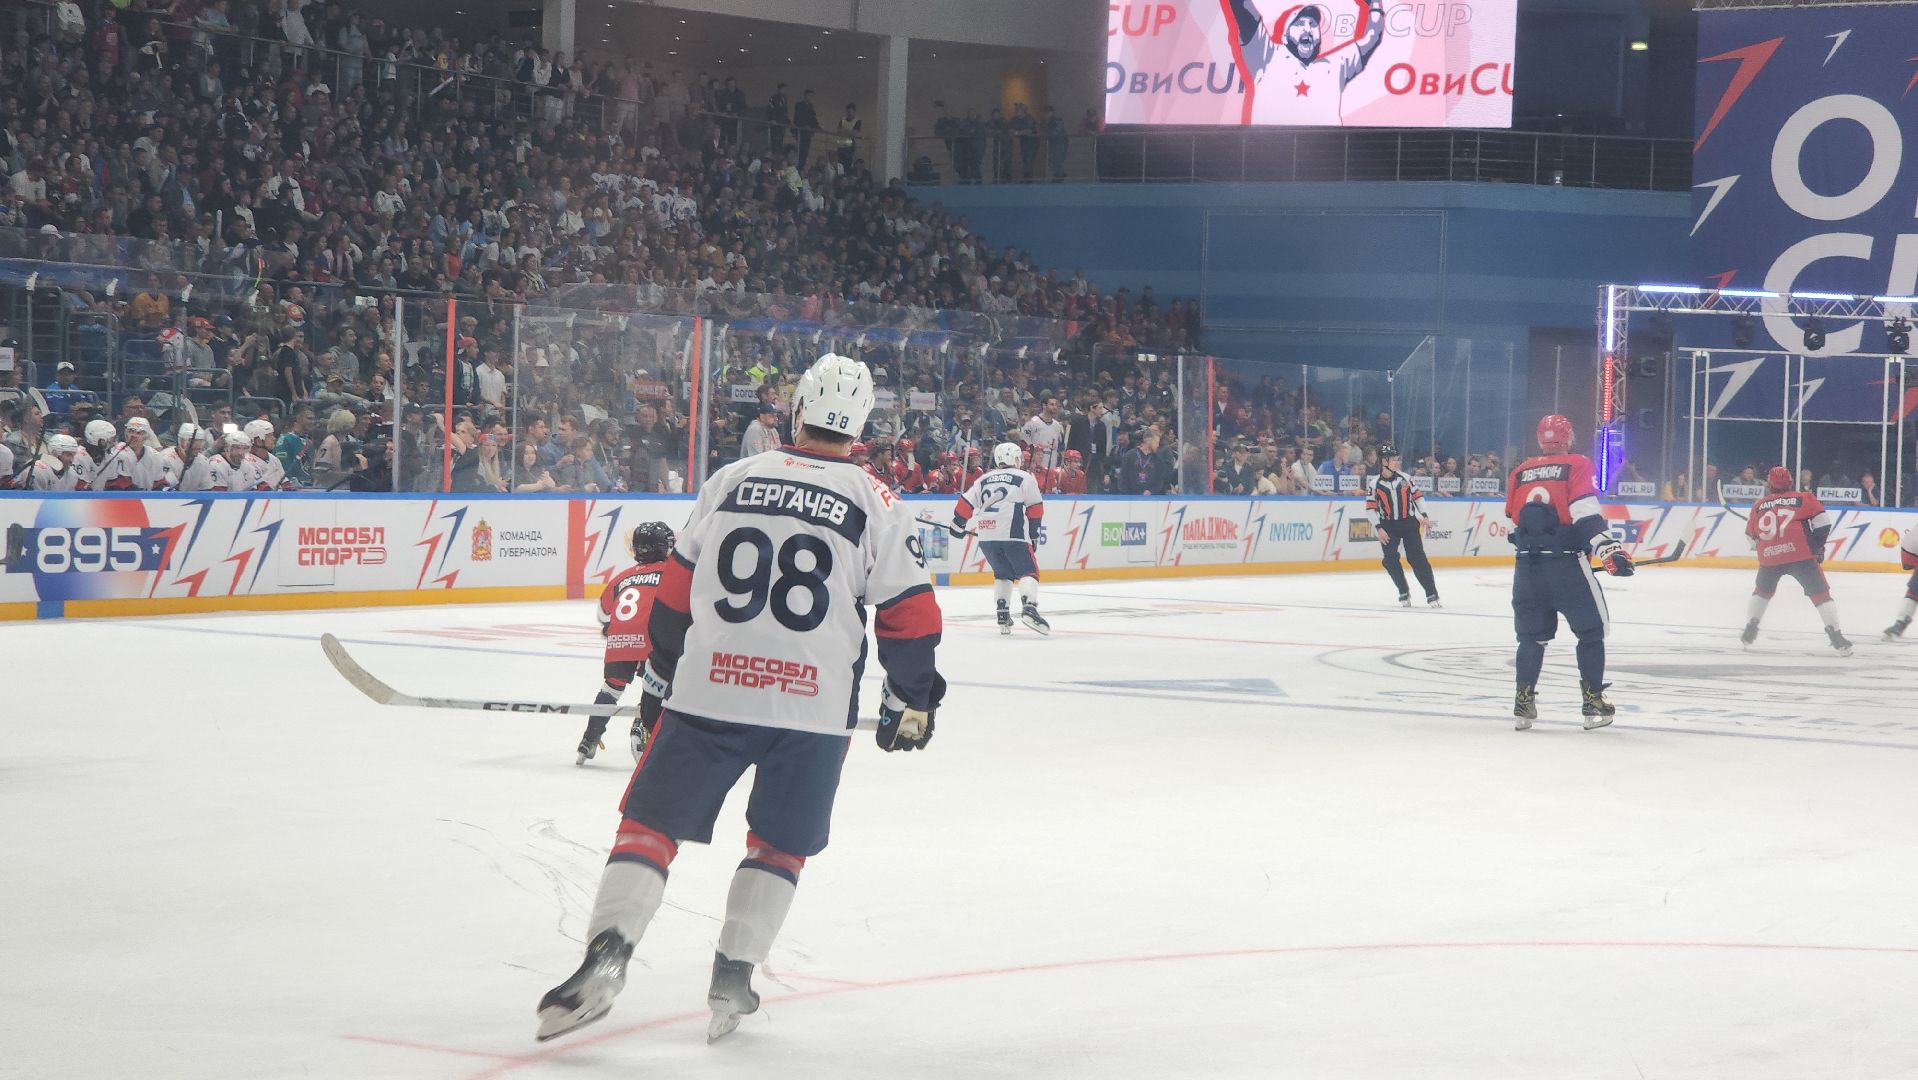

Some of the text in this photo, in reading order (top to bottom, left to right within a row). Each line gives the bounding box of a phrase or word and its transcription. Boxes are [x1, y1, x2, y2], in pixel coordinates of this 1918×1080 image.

[1104, 61, 1244, 94] ОвиCU
[826, 411, 849, 430] 98
[1725, 486, 1762, 497] KHL.RU
[1820, 488, 1859, 499] KHL.RU
[735, 480, 849, 526] СЕРГАЧЕВ
[499, 530, 543, 541] КОМАНДА
[1183, 517, 1238, 541] ПАПА ДЖОНС
[1269, 522, 1313, 542] INVITRO
[1758, 508, 1796, 541] 97
[36, 527, 143, 573] 895
[298, 547, 366, 566] СПОРТ
[499, 547, 558, 558] ГУБЕРНАТОРА
[713, 526, 832, 631] 98
[615, 587, 640, 622] 8
[709, 668, 794, 693] СПОРТ
[483, 701, 571, 714] CCM
